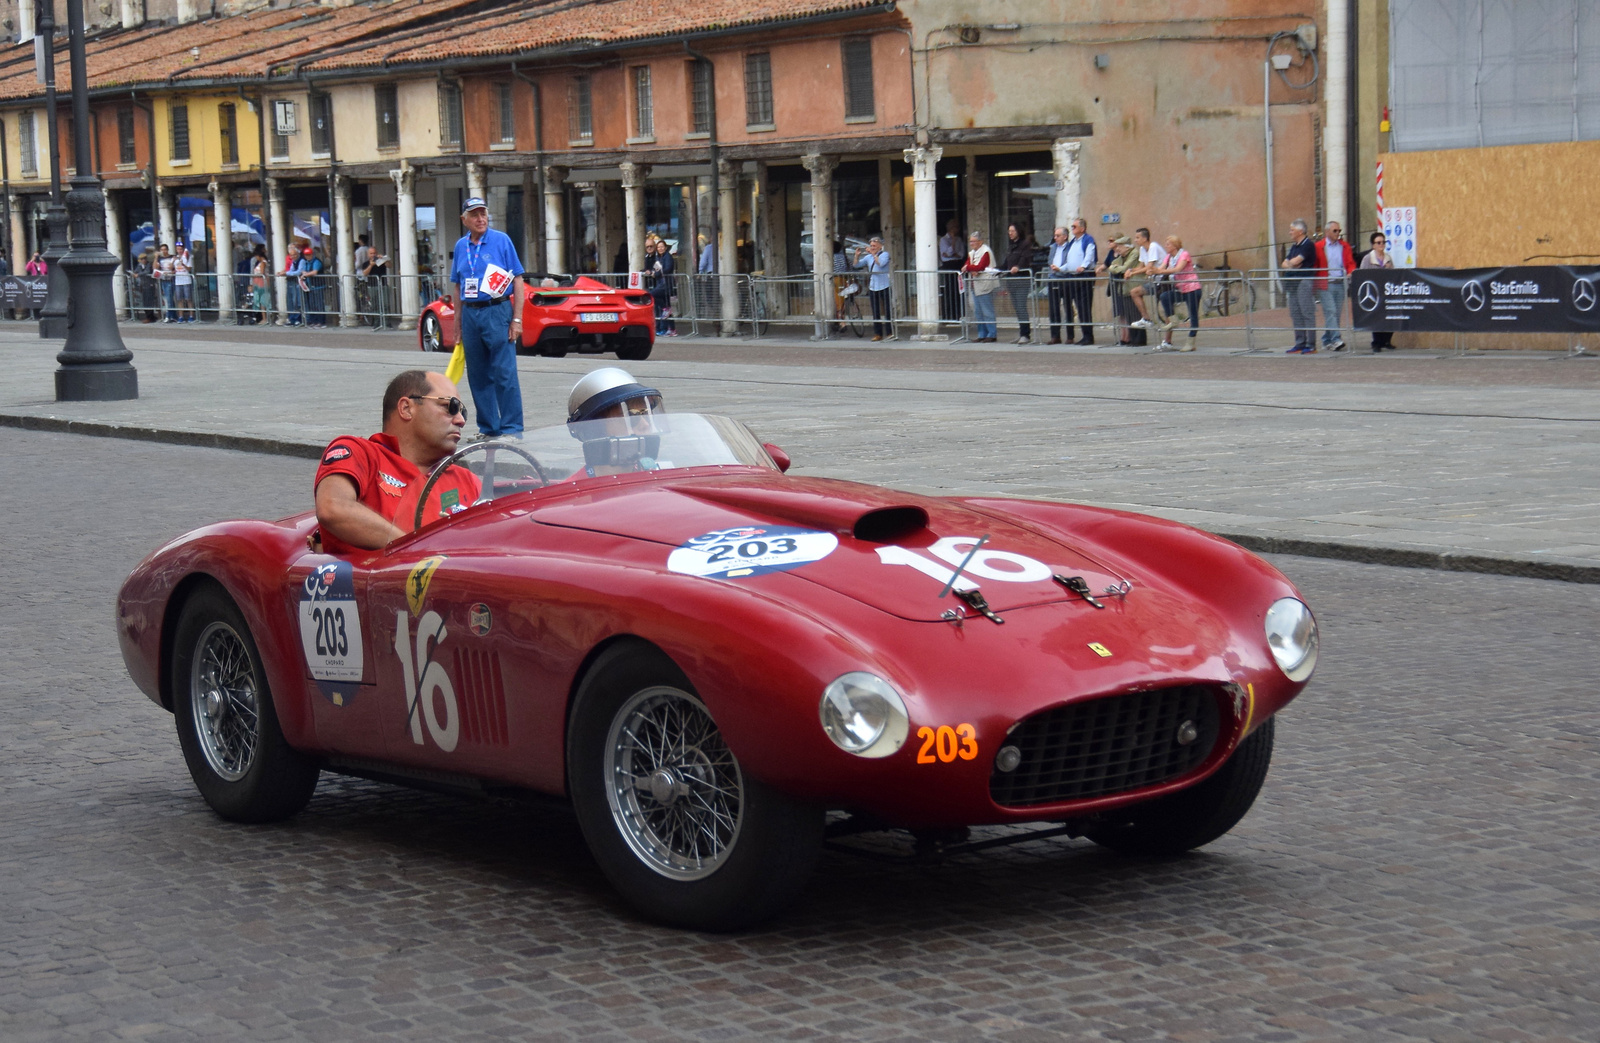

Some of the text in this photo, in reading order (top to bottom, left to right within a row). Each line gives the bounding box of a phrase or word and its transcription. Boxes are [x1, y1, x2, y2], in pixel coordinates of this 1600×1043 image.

[1384, 281, 1431, 296] StarEmilia
[1490, 280, 1539, 295] StarEmilia
[707, 537, 798, 564] 203
[873, 535, 1051, 592] 16
[313, 607, 348, 657] 203
[394, 609, 460, 753] 16
[916, 722, 979, 765] 203
